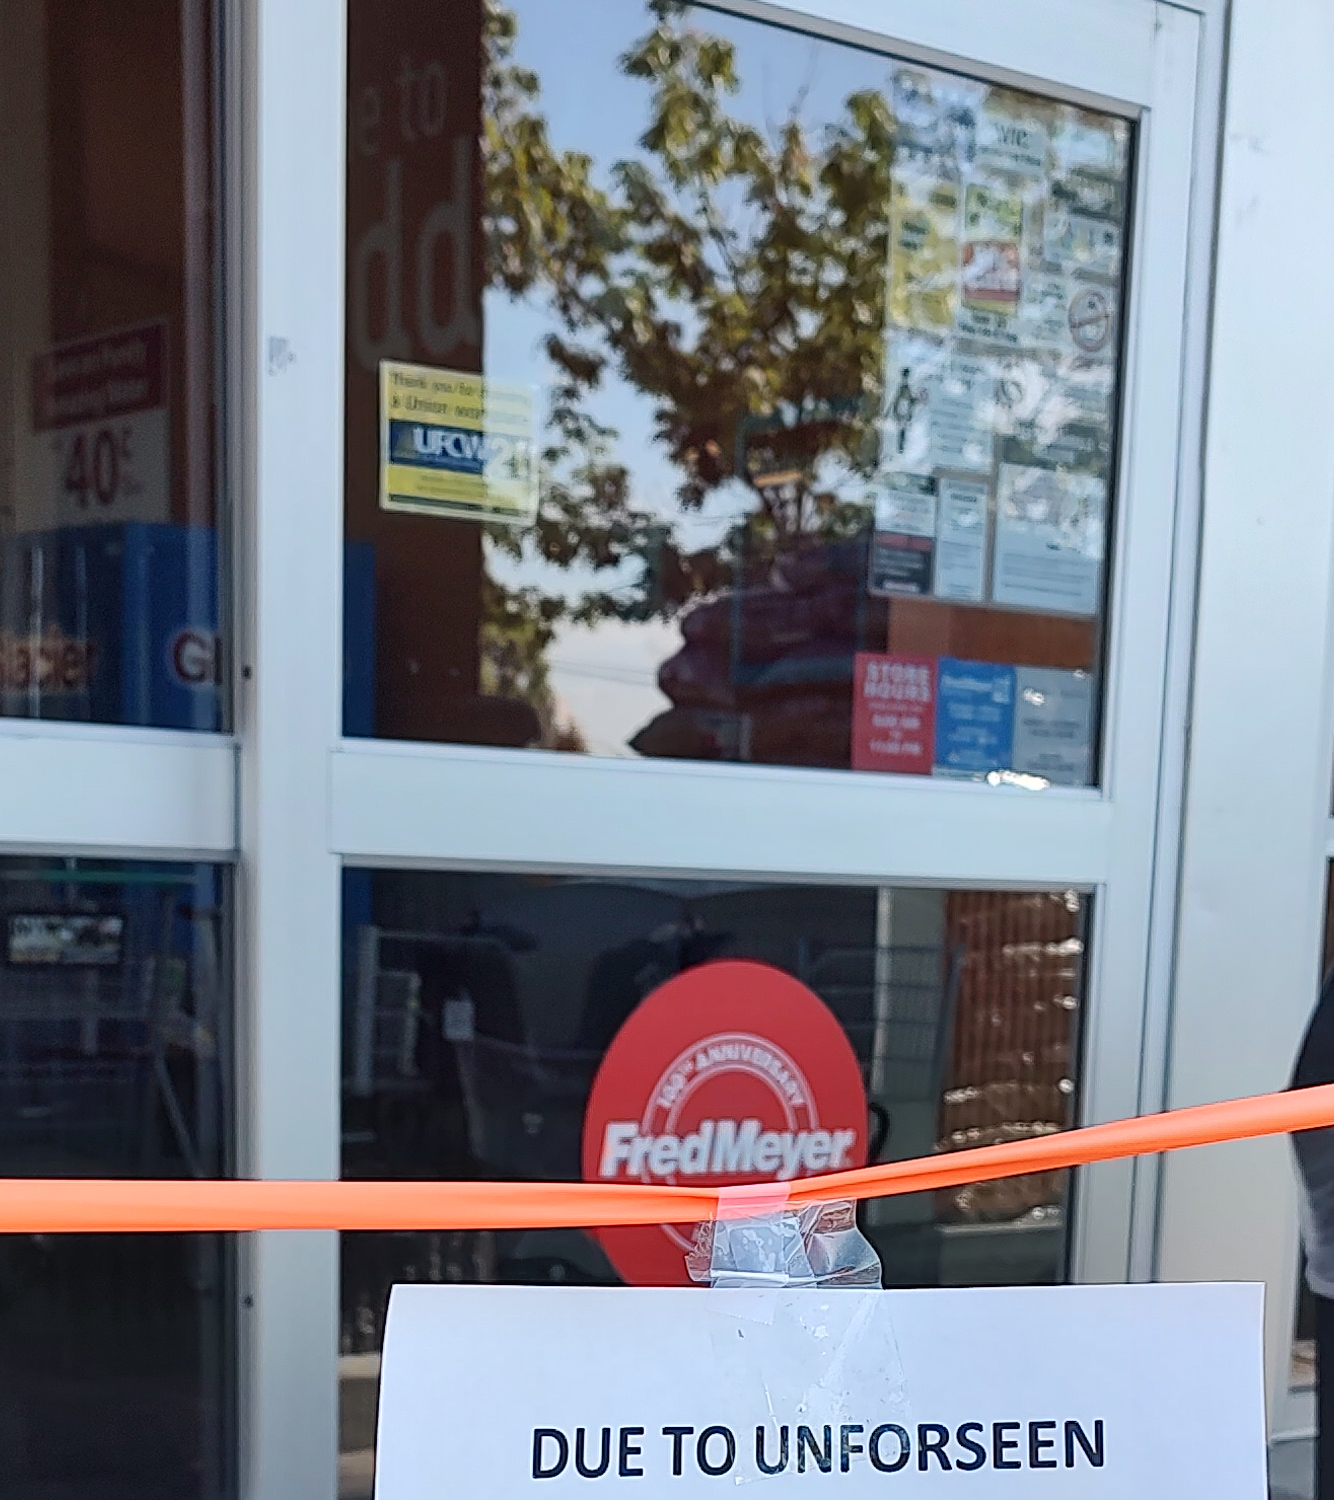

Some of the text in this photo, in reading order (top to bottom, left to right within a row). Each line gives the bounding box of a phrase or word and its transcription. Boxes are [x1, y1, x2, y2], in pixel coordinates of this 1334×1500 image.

[695, 1043, 805, 1105] ANNIVERSARY
[531, 1418, 1105, 1481] DUE TO UNFORSEEN
